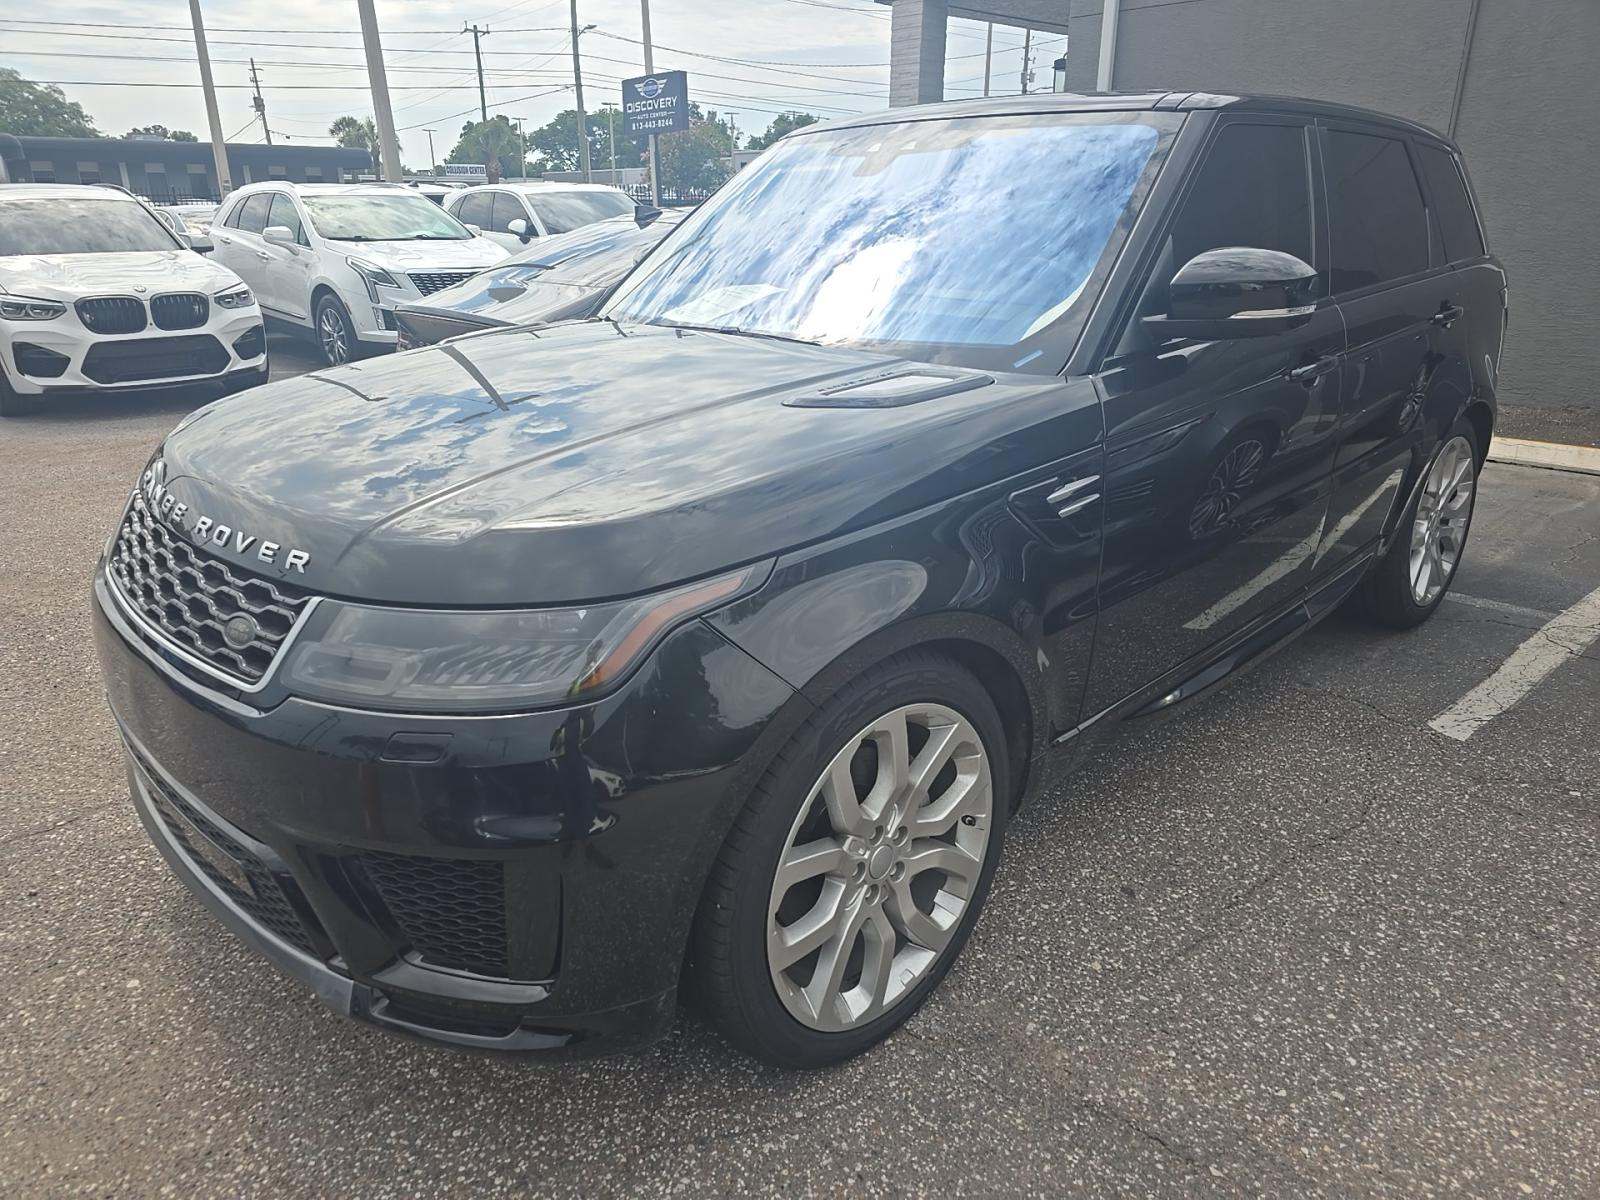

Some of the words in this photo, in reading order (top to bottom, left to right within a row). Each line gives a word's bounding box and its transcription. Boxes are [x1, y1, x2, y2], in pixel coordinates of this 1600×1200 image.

[626, 96, 677, 113] DISCOVERY
[447, 165, 468, 174] COLLISION
[469, 166, 486, 175] CENTER
[194, 516, 310, 573] ROVER
